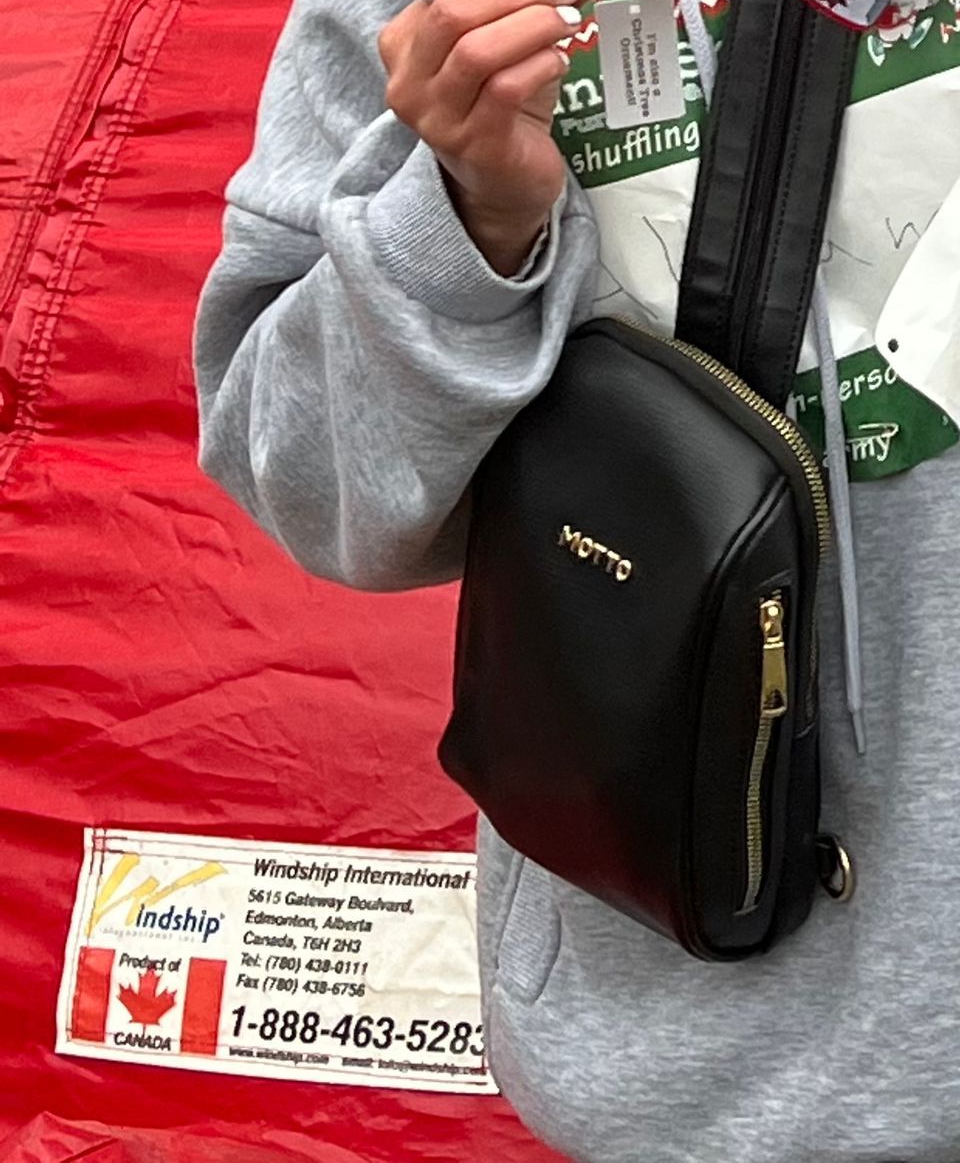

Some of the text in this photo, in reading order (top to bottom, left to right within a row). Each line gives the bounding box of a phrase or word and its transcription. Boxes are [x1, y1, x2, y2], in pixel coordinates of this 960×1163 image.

[630, 17, 650, 118] Christmas Tree
[649, 58, 660, 87] also
[571, 120, 701, 174] shuffling
[558, 525, 632, 581] MOTTO
[253, 857, 471, 890] Windship International
[247, 888, 282, 905] 5615
[285, 890, 346, 912] Gateway
[245, 909, 373, 933] Edmonton, Alberta
[243, 930, 363, 954] Canada, T6H 2H3
[119, 952, 182, 973] Product of
[265, 954, 302, 974] (780)
[305, 957, 369, 976] 438-0111
[235, 973, 367, 998] Fax (780) 438-6756
[113, 1031, 172, 1052] CANADA
[231, 1004, 486, 1057] 1-888-463-5283
